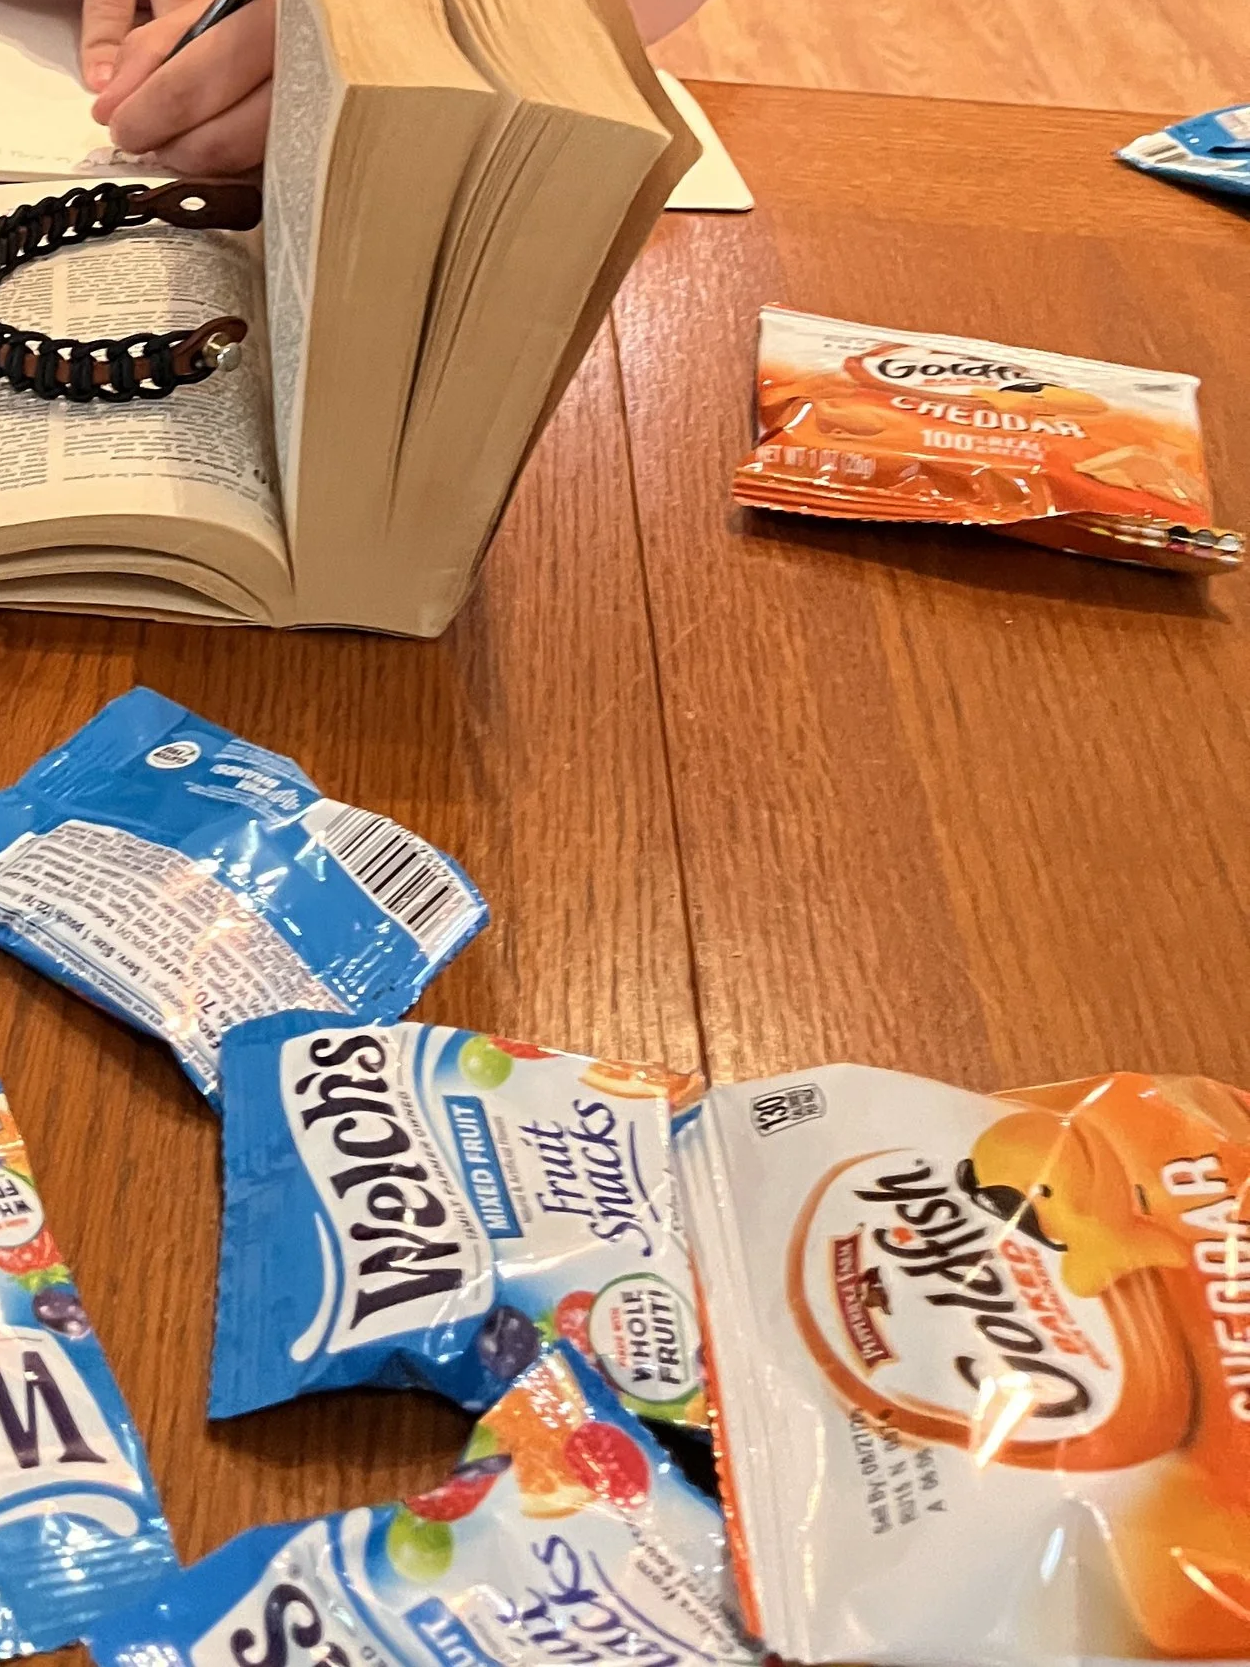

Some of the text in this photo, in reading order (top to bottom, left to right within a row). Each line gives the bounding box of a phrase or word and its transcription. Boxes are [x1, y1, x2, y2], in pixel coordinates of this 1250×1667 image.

[890, 395, 1087, 439] CHEDDAR
[451, 1103, 511, 1230] MIXED FRUIT
[519, 1119, 573, 1217] Fruit
[753, 1095, 790, 1131] 130
[295, 1034, 464, 1331] Welch's
[568, 1098, 654, 1257] Snacks
[620, 1290, 652, 1382] WHOLE
[854, 1158, 1091, 1418] Goldfish
